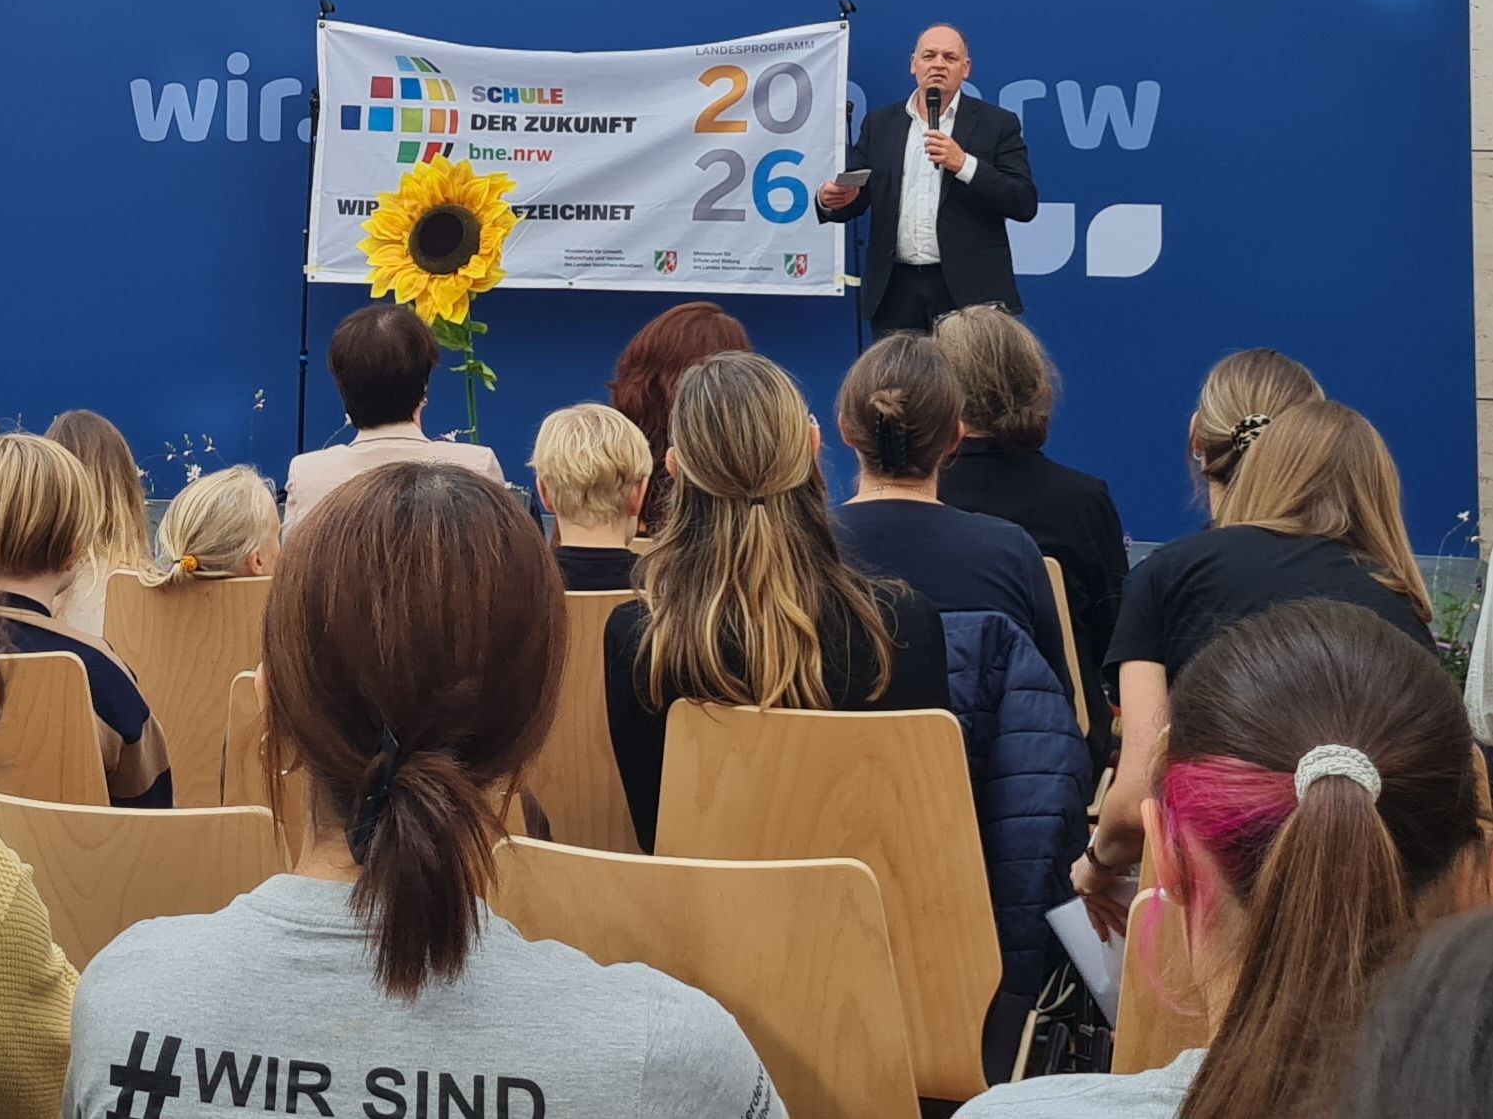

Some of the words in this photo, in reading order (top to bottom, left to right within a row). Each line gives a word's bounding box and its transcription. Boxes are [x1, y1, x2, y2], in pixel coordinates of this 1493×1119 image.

[695, 40, 815, 56] LANDESPROGRAMM
[471, 85, 564, 105] SCHULE
[694, 61, 813, 135] 20
[470, 113, 518, 132] DER
[524, 115, 638, 134] ZUKUNFT
[468, 143, 553, 162] bne.nrw
[692, 148, 809, 224] 26
[362, 1066, 547, 1119] SIND
